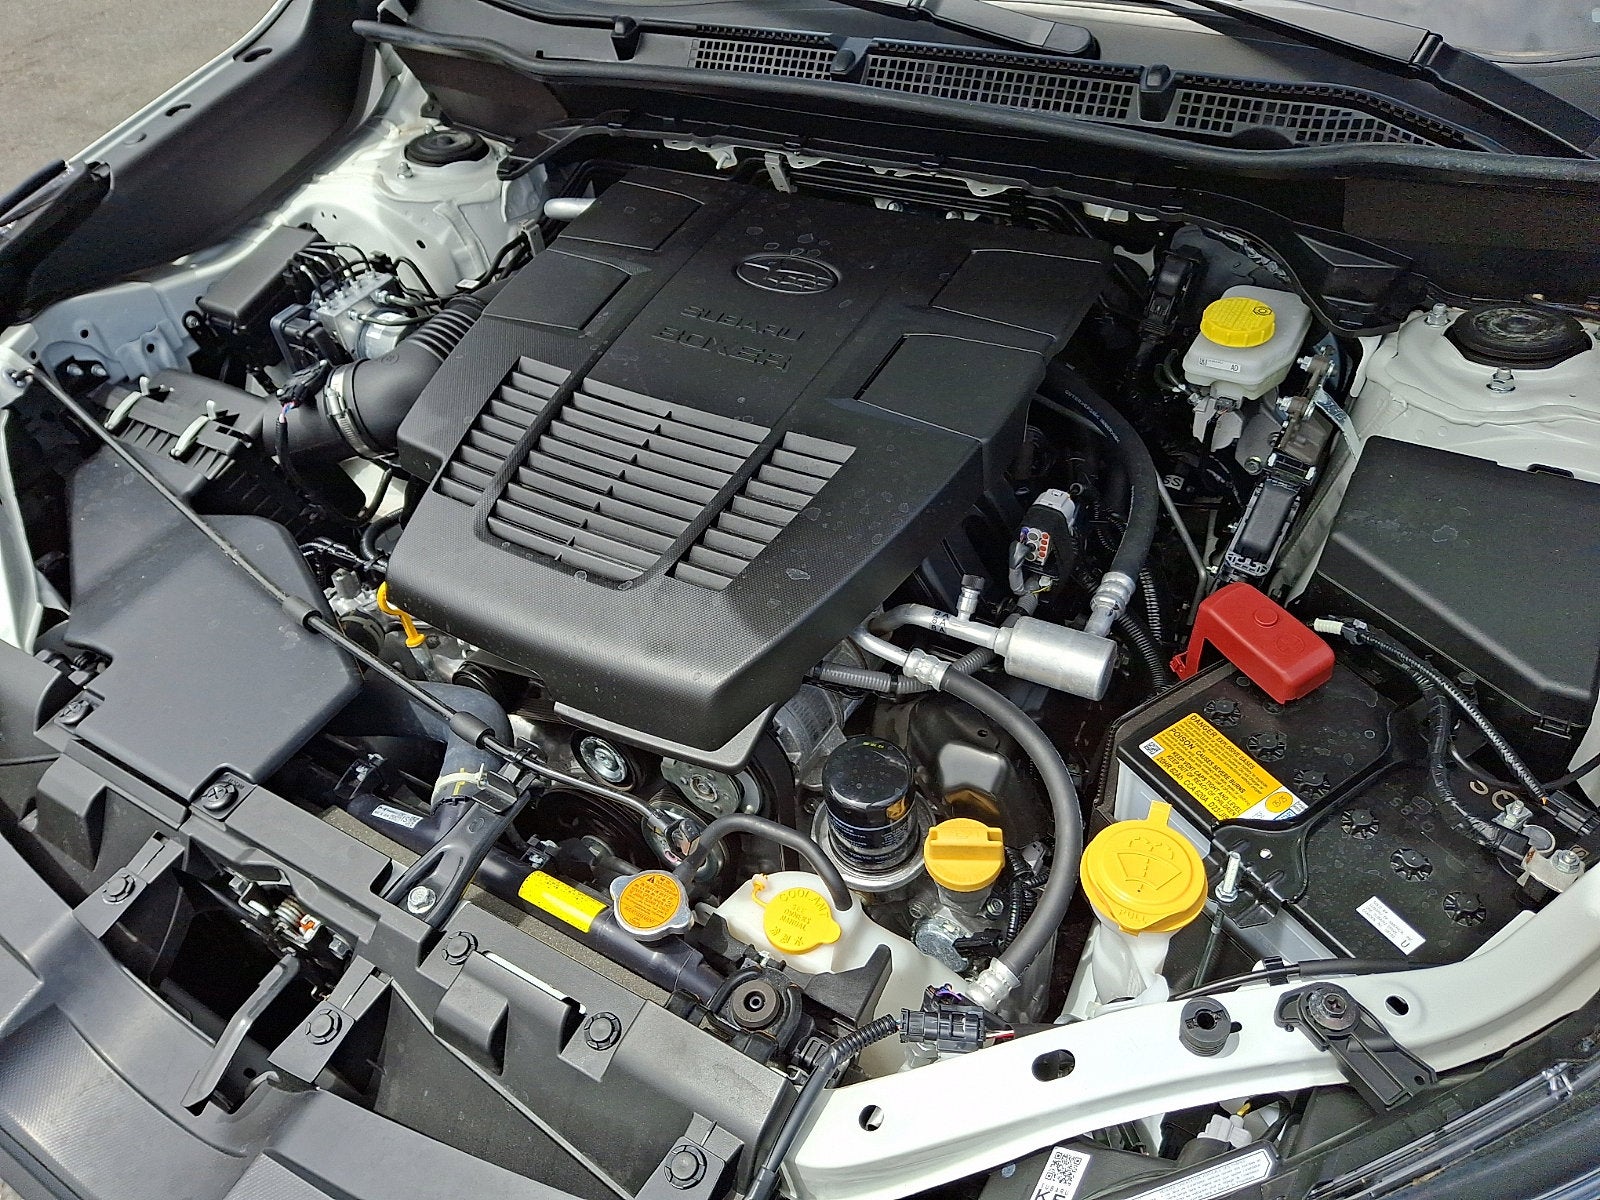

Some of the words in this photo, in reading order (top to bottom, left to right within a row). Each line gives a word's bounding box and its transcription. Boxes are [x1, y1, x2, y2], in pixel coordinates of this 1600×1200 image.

[680, 305, 805, 341] SUBARU
[651, 326, 792, 373] BOXER
[1190, 715, 1218, 737] DANGER
[1169, 728, 1195, 750] POISON
[1196, 750, 1214, 766] CAUSES
[780, 889, 829, 918] COOLANT
